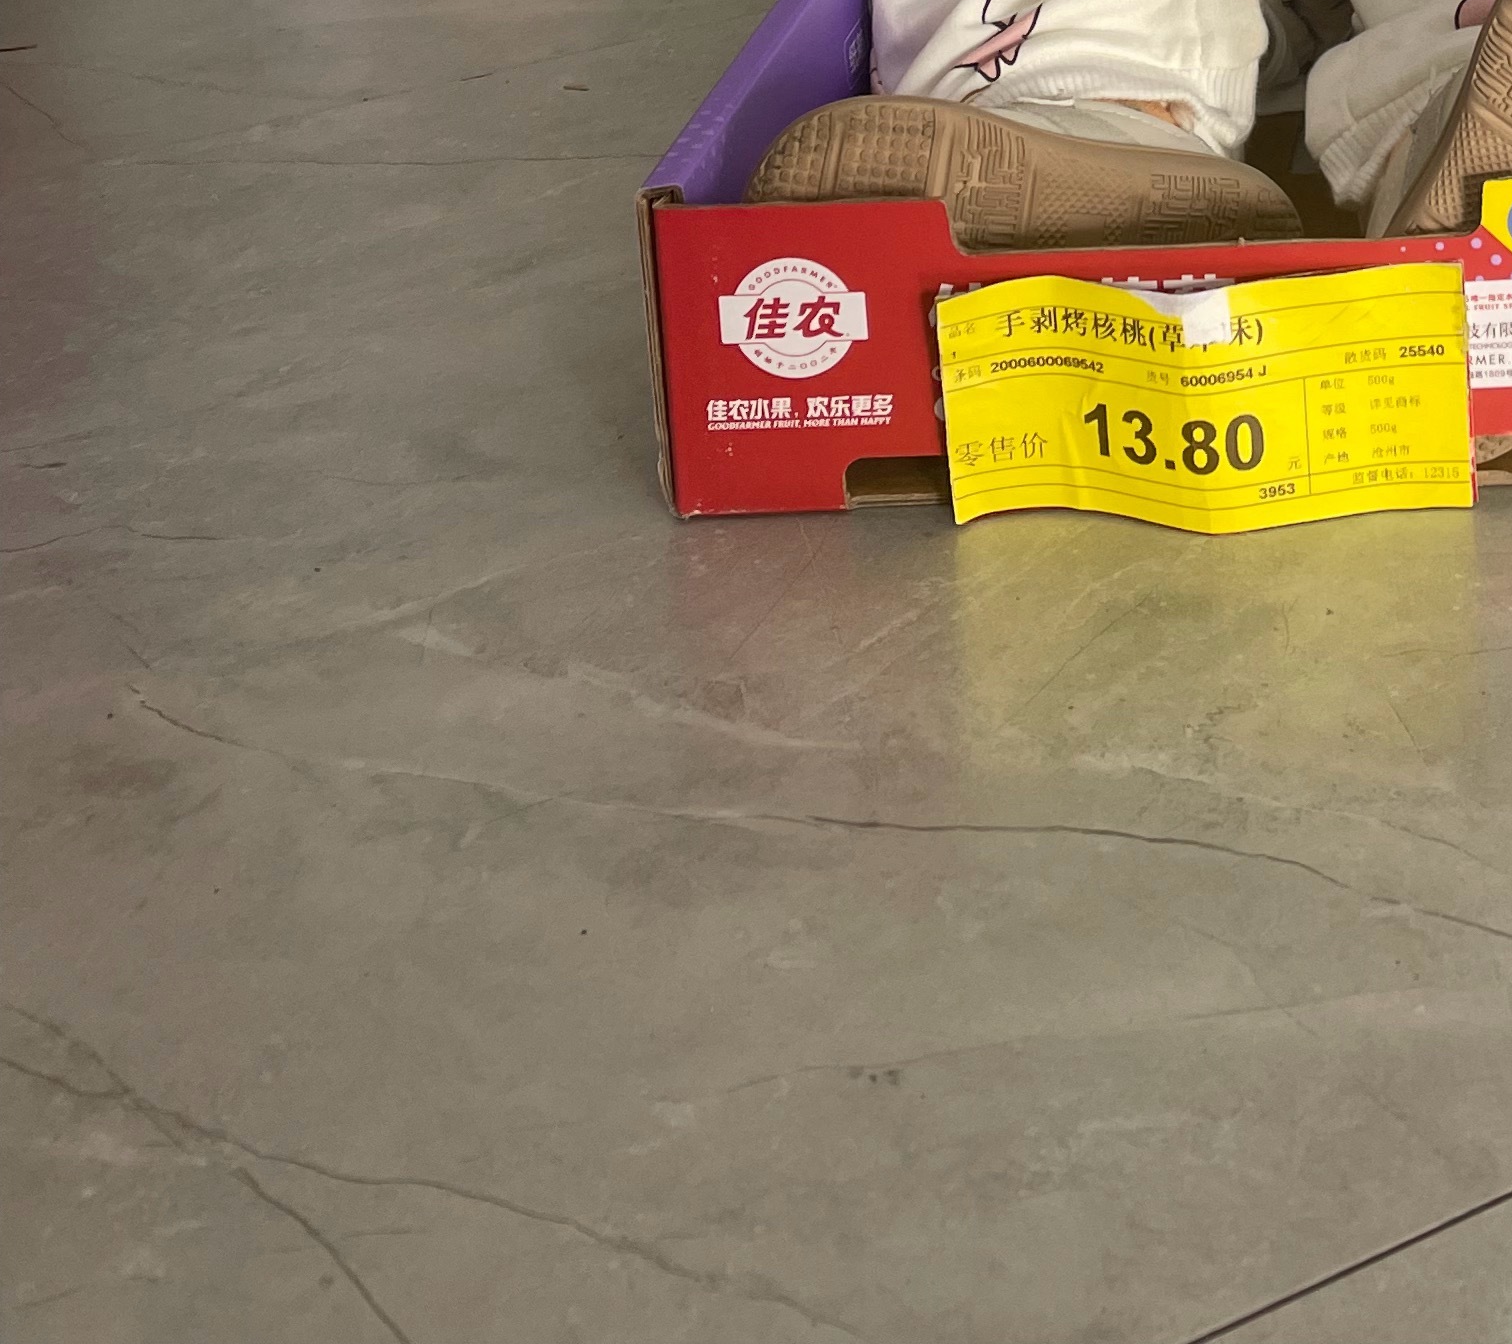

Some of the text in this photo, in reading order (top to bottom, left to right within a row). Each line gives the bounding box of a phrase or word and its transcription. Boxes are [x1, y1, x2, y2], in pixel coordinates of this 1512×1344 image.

[743, 295, 844, 342] 佳农
[1399, 344, 1446, 359] 25540
[1367, 375, 1395, 386] 500g
[1369, 423, 1397, 435] 500g
[953, 432, 1050, 469] 零售价
[1083, 402, 1266, 478] 13.80
[1258, 482, 1296, 500] 3953
